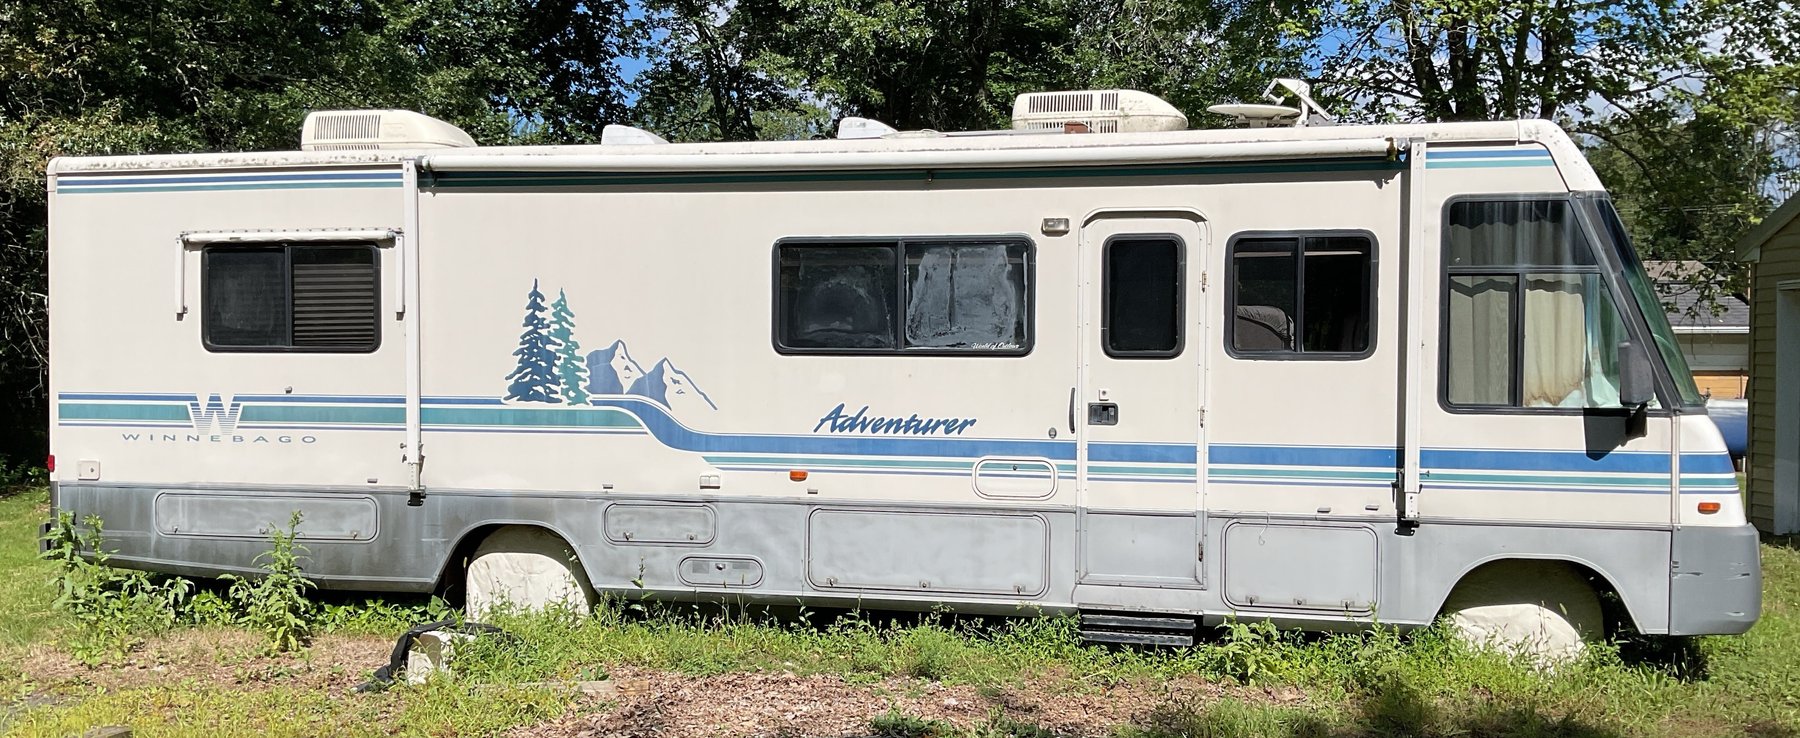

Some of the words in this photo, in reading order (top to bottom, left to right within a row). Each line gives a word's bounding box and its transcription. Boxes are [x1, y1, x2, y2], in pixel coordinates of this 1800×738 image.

[971, 342, 991, 350] World
[990, 342, 998, 351] of
[813, 402, 977, 435] Adventurer
[122, 433, 317, 444] WINNEBAGO
